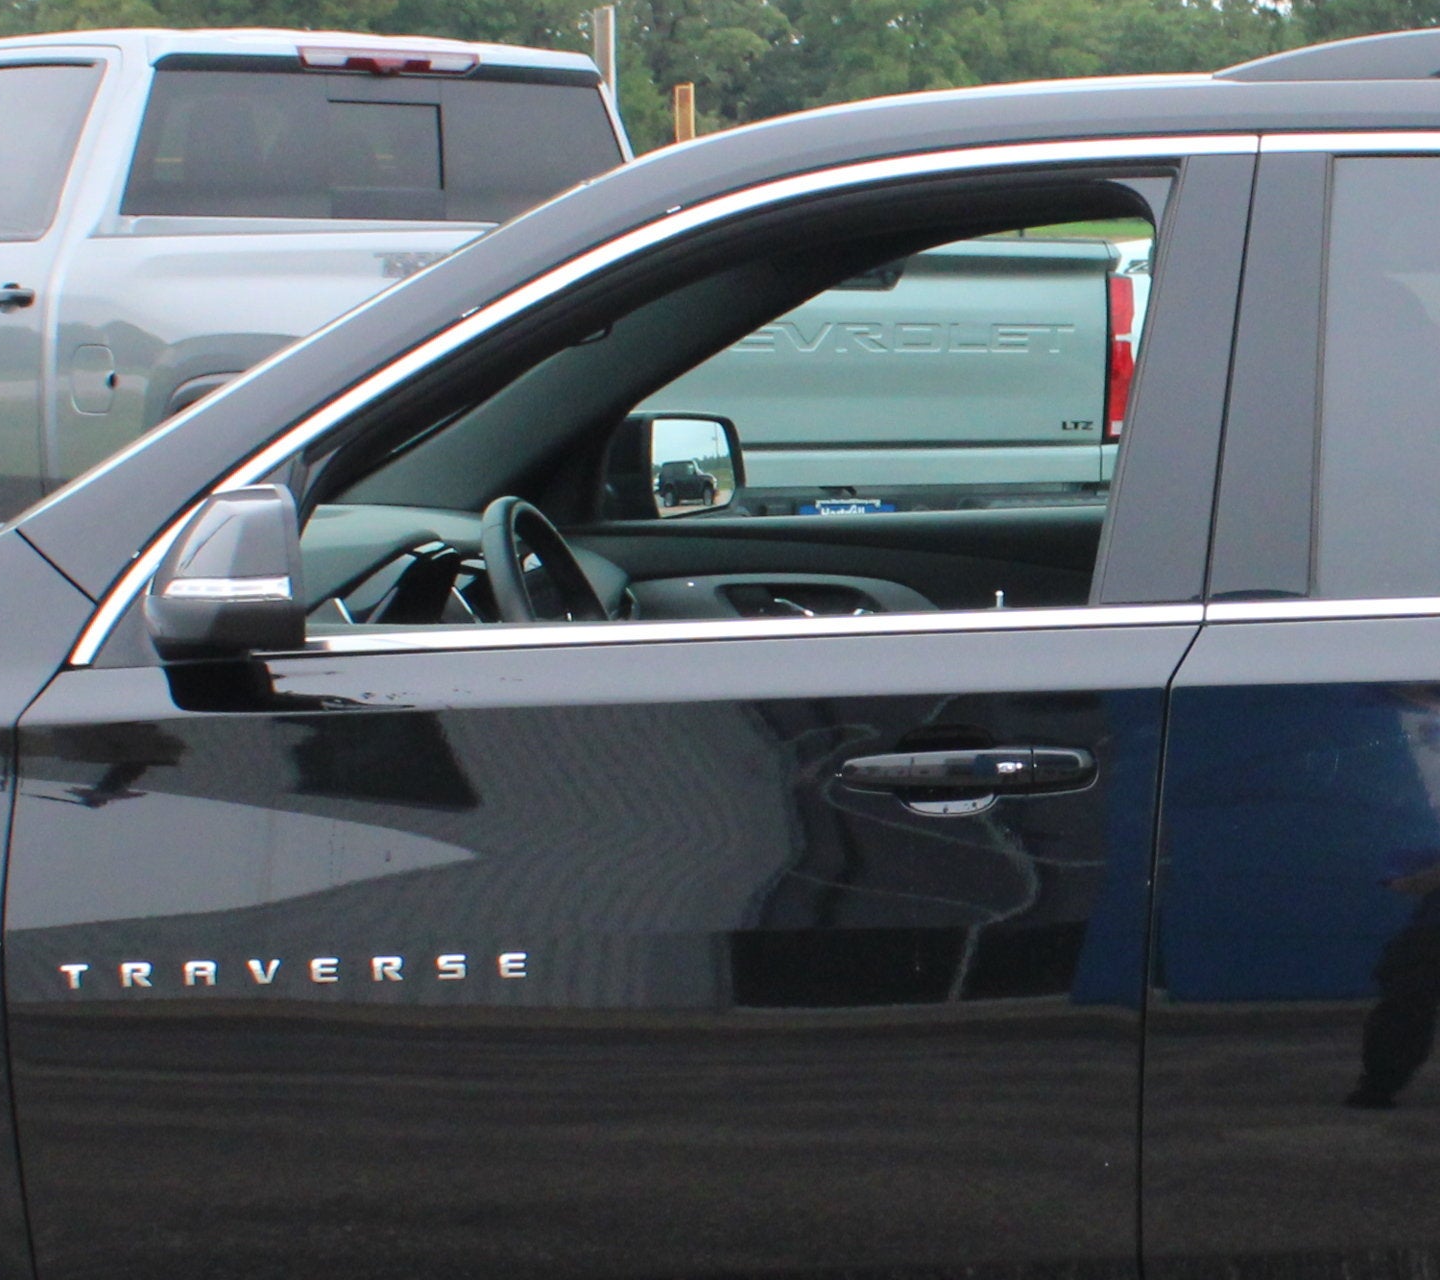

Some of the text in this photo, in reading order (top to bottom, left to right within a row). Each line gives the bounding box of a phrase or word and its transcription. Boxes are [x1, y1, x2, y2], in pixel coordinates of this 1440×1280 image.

[723, 321, 1075, 353] EVROLET
[1061, 421, 1094, 431] LTZ
[60, 952, 528, 989] TRAVERSE
